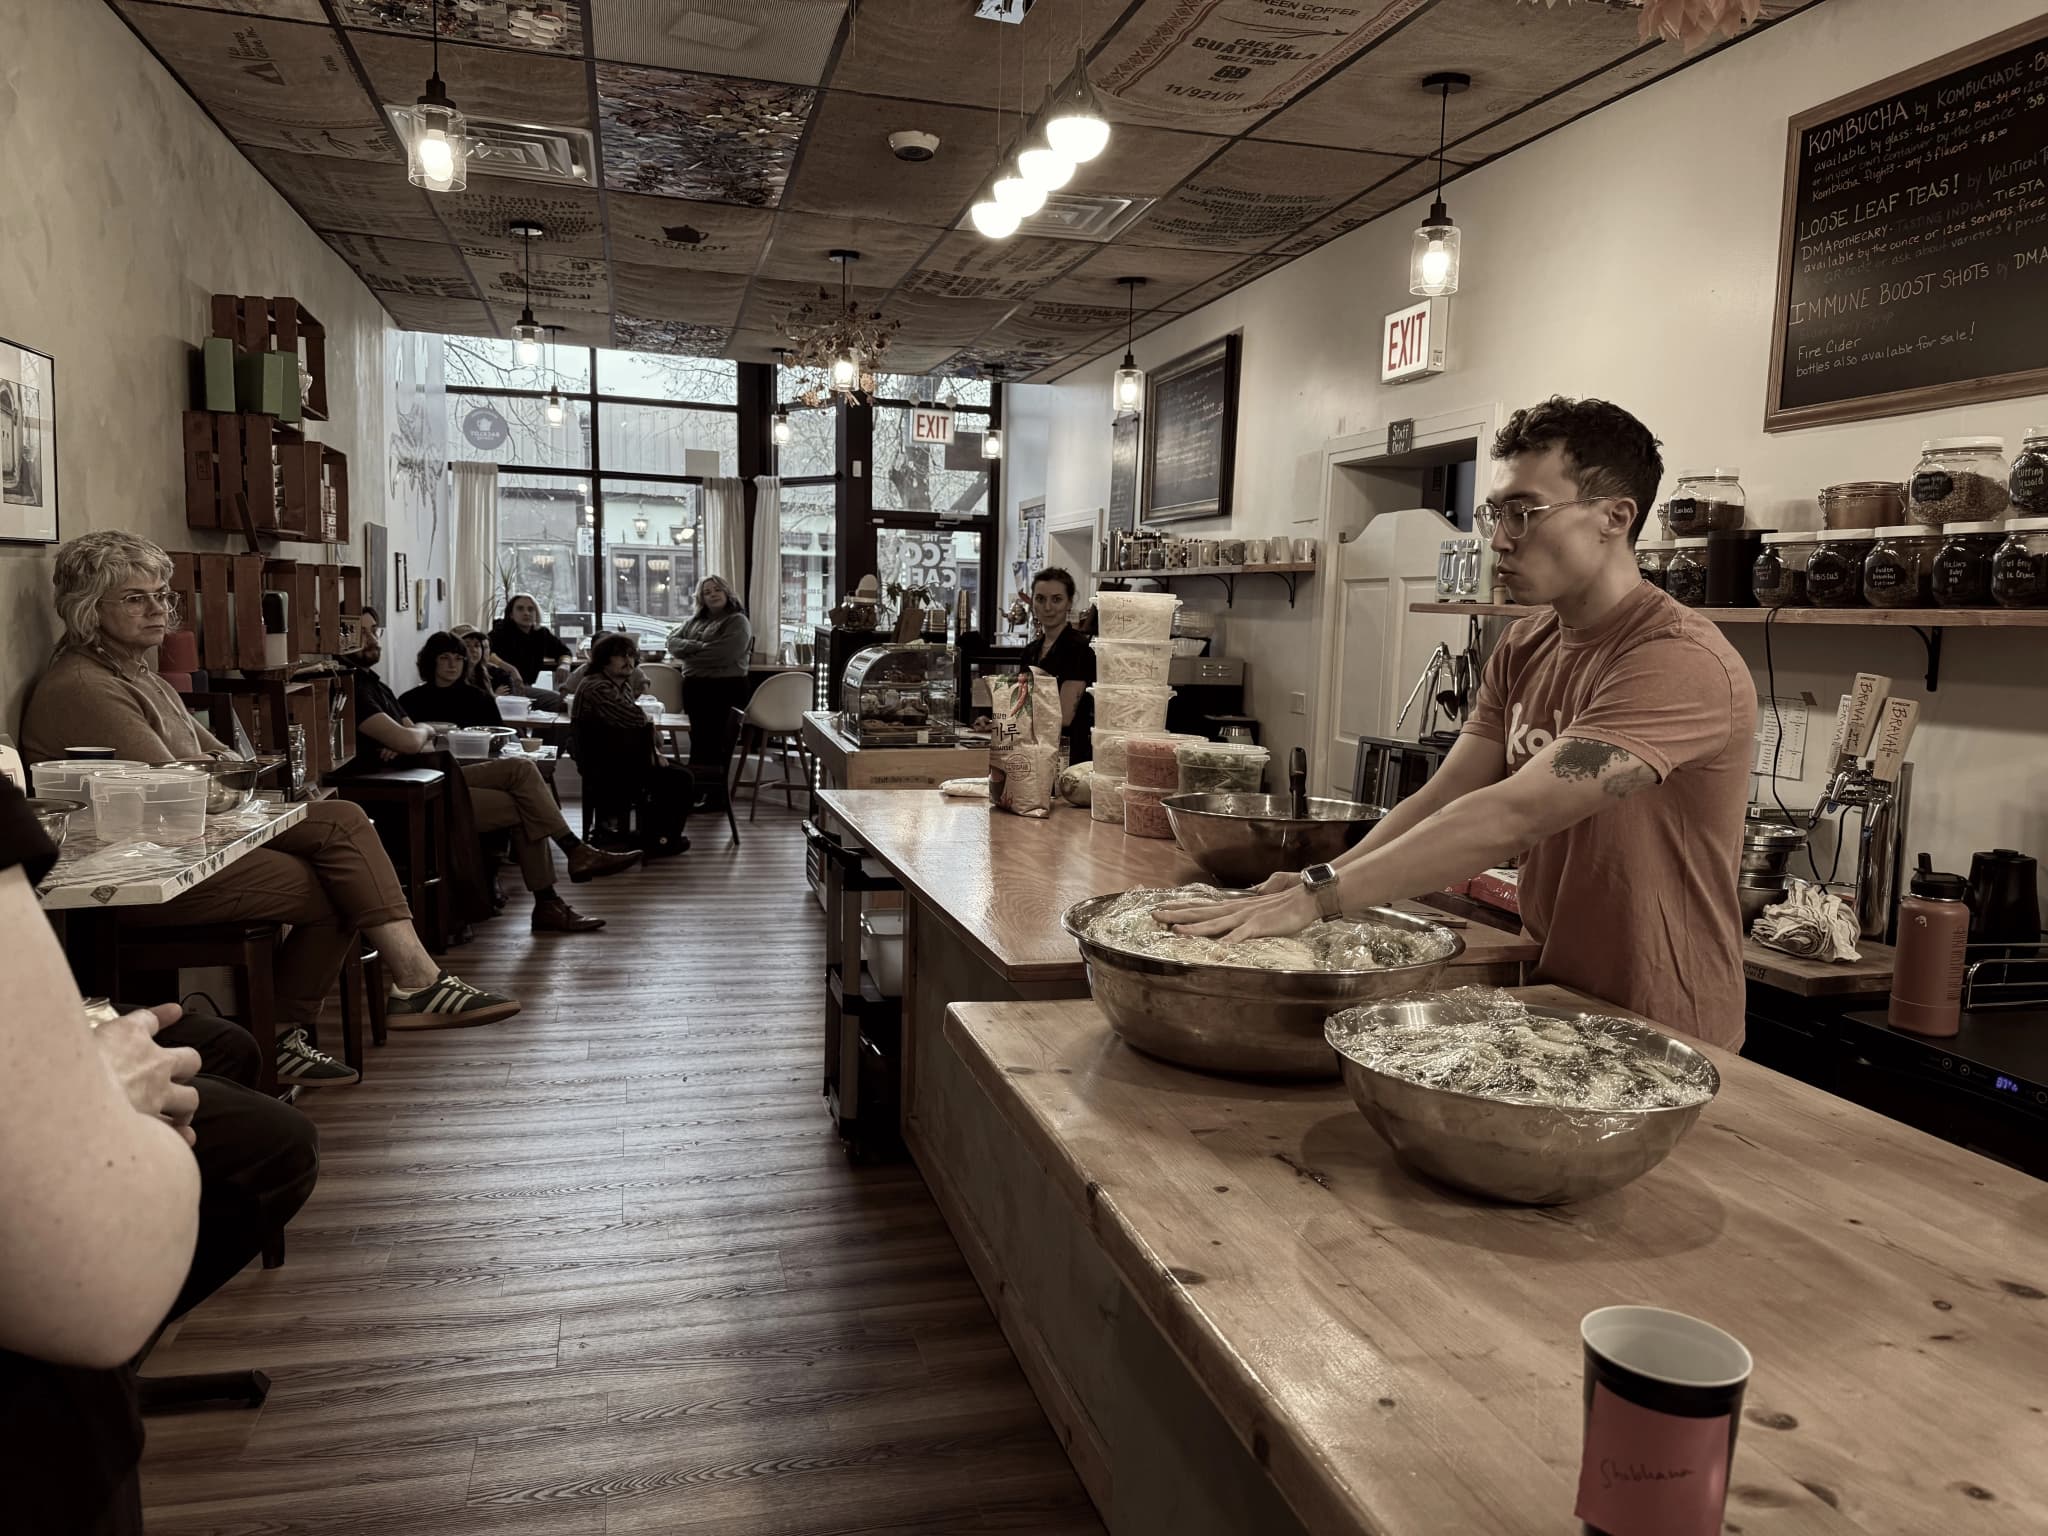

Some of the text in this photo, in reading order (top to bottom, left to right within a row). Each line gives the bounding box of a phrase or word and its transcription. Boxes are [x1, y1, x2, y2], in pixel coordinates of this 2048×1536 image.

[1263, 7, 1330, 22] ARABICA
[1302, 4, 1361, 17] COFFEE
[1191, 36, 1319, 60] GUATEMALA
[1275, 43, 1297, 52] DE
[1808, 101, 1909, 157] KOMBUCHA
[1915, 101, 1929, 121] by
[1937, 60, 2024, 110] KOMBUCHADE
[1814, 144, 1867, 173] available
[1870, 139, 1882, 154] by
[1825, 173, 1834, 183] in
[1835, 164, 1857, 184] your
[1859, 155, 1880, 170] own
[1883, 138, 1932, 163] container
[1974, 107, 2017, 129] ounce
[1811, 177, 1861, 202] Kombucha
[1864, 163, 1895, 184] flights
[1905, 155, 1922, 174] any
[1934, 140, 1969, 161] flavors
[1800, 208, 1849, 242] LOOSE
[1854, 192, 1900, 223] LEAF
[1906, 172, 1960, 206] TEAS!
[1968, 172, 1983, 194] by
[1946, 199, 1985, 222] INDIA
[1993, 178, 2046, 203] TIESTA
[1804, 251, 1854, 273] available
[1857, 248, 1870, 261] by
[1871, 243, 1887, 254] the
[1890, 234, 1920, 251] ounce
[1924, 228, 1940, 241] or
[2016, 196, 2046, 213] free
[1891, 253, 1912, 265] ask
[1789, 287, 1872, 326] IMMUNE
[1879, 272, 1937, 305] BOOST
[1388, 311, 1426, 371] EXIT
[1797, 360, 1830, 377] bottles
[1833, 352, 1857, 368] also
[1861, 343, 1913, 362] available
[1916, 336, 1937, 351] for
[1798, 337, 1862, 360] Fire Cider
[916, 414, 950, 440] EXIT
[1392, 424, 1410, 442] Staff
